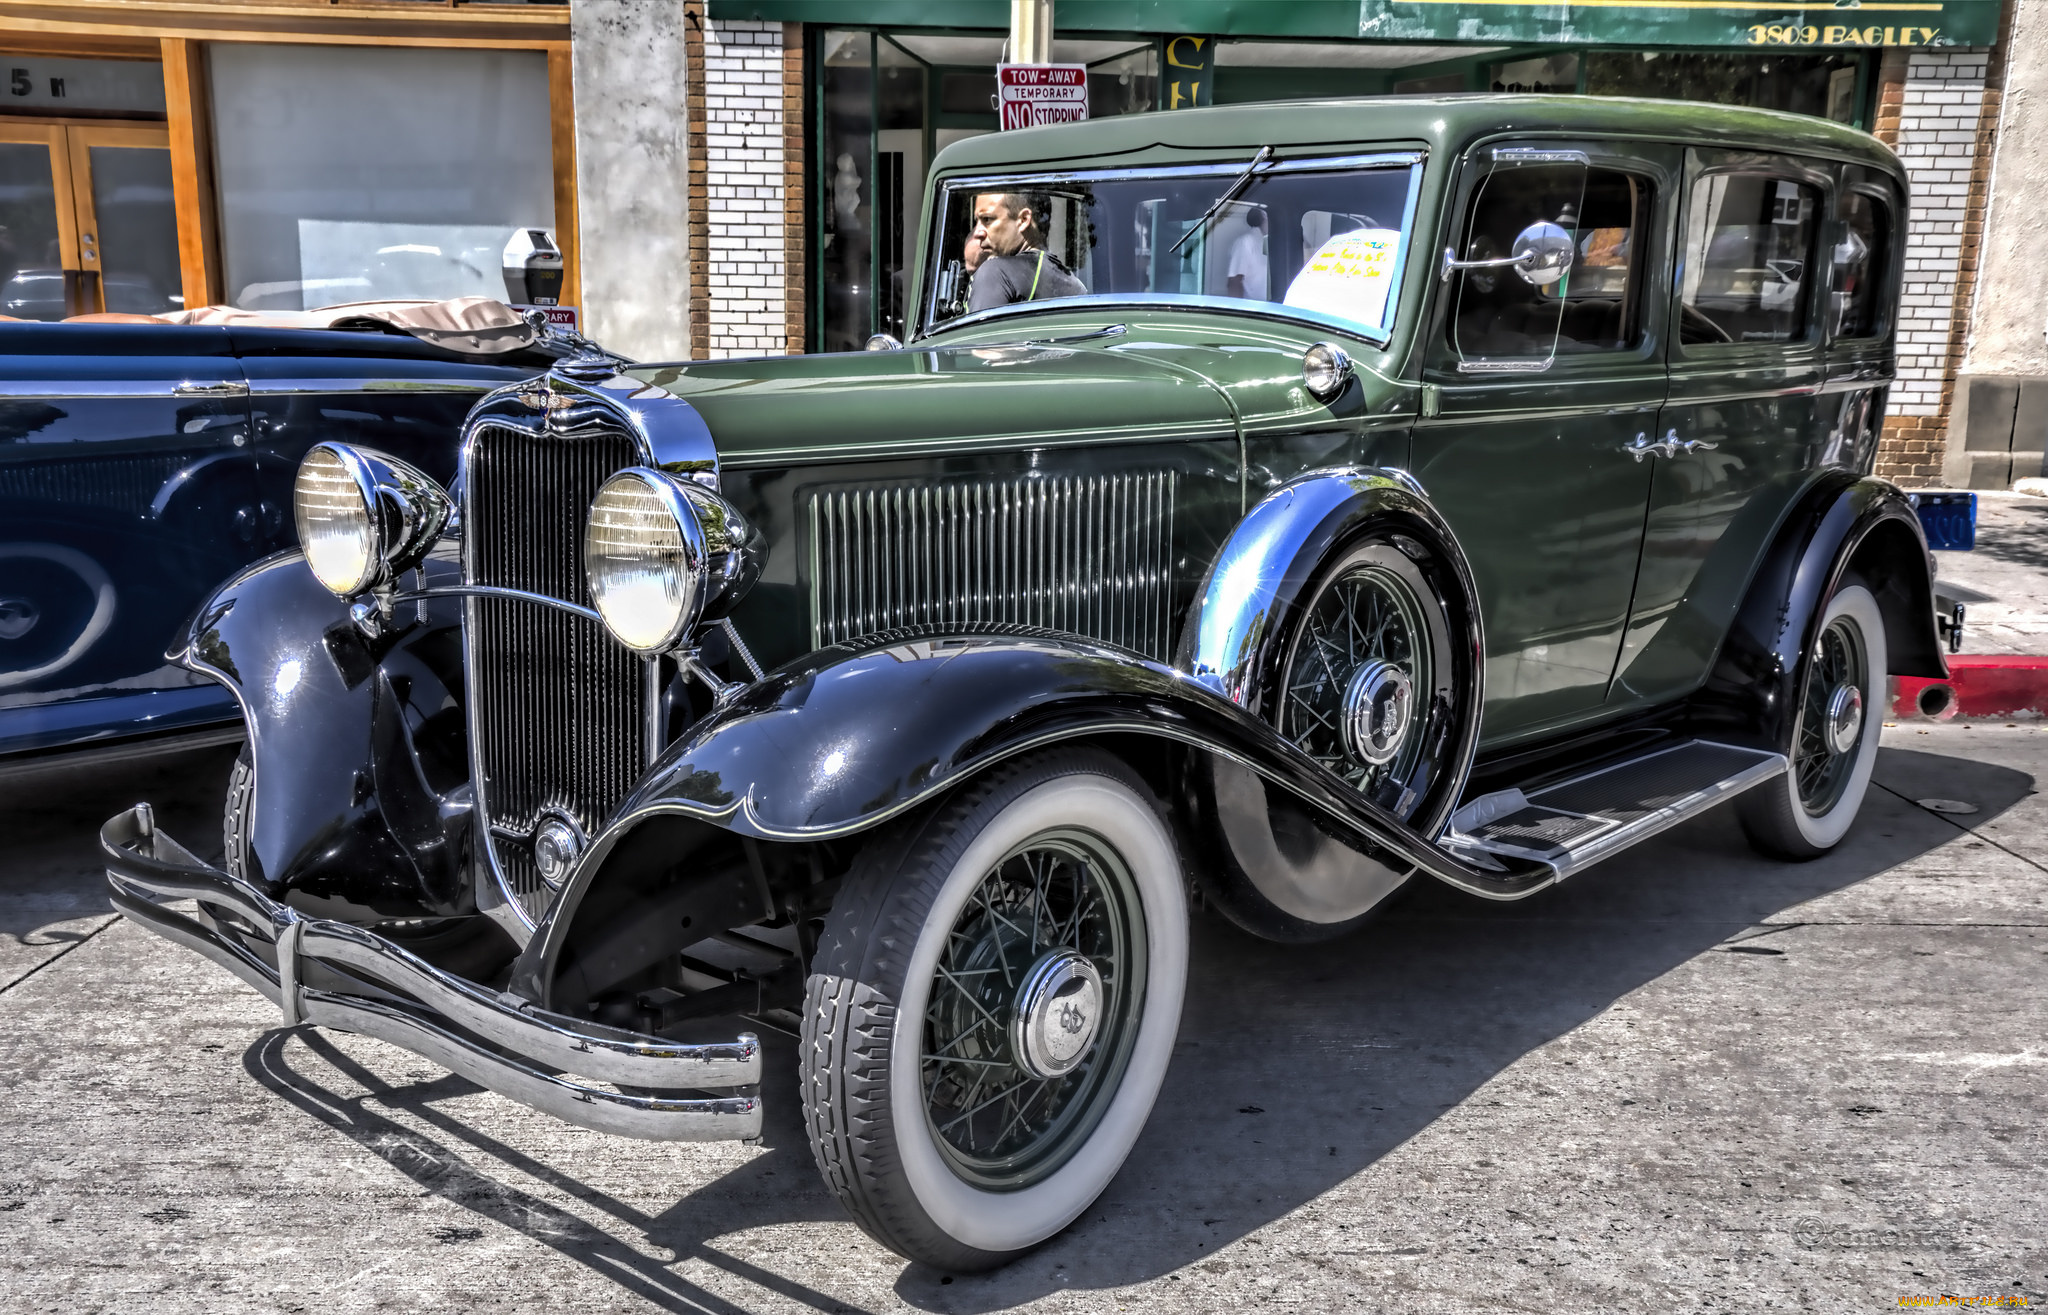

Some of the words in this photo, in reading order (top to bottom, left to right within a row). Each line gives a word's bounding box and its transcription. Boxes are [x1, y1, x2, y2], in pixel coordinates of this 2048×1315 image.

[1747, 24, 1819, 45] 3809
[1823, 25, 1940, 46] BAGLEY
[1010, 70, 1077, 84] TOW-AWAY
[1014, 88, 1075, 99] TEMPORARY
[1007, 103, 1032, 130] NO
